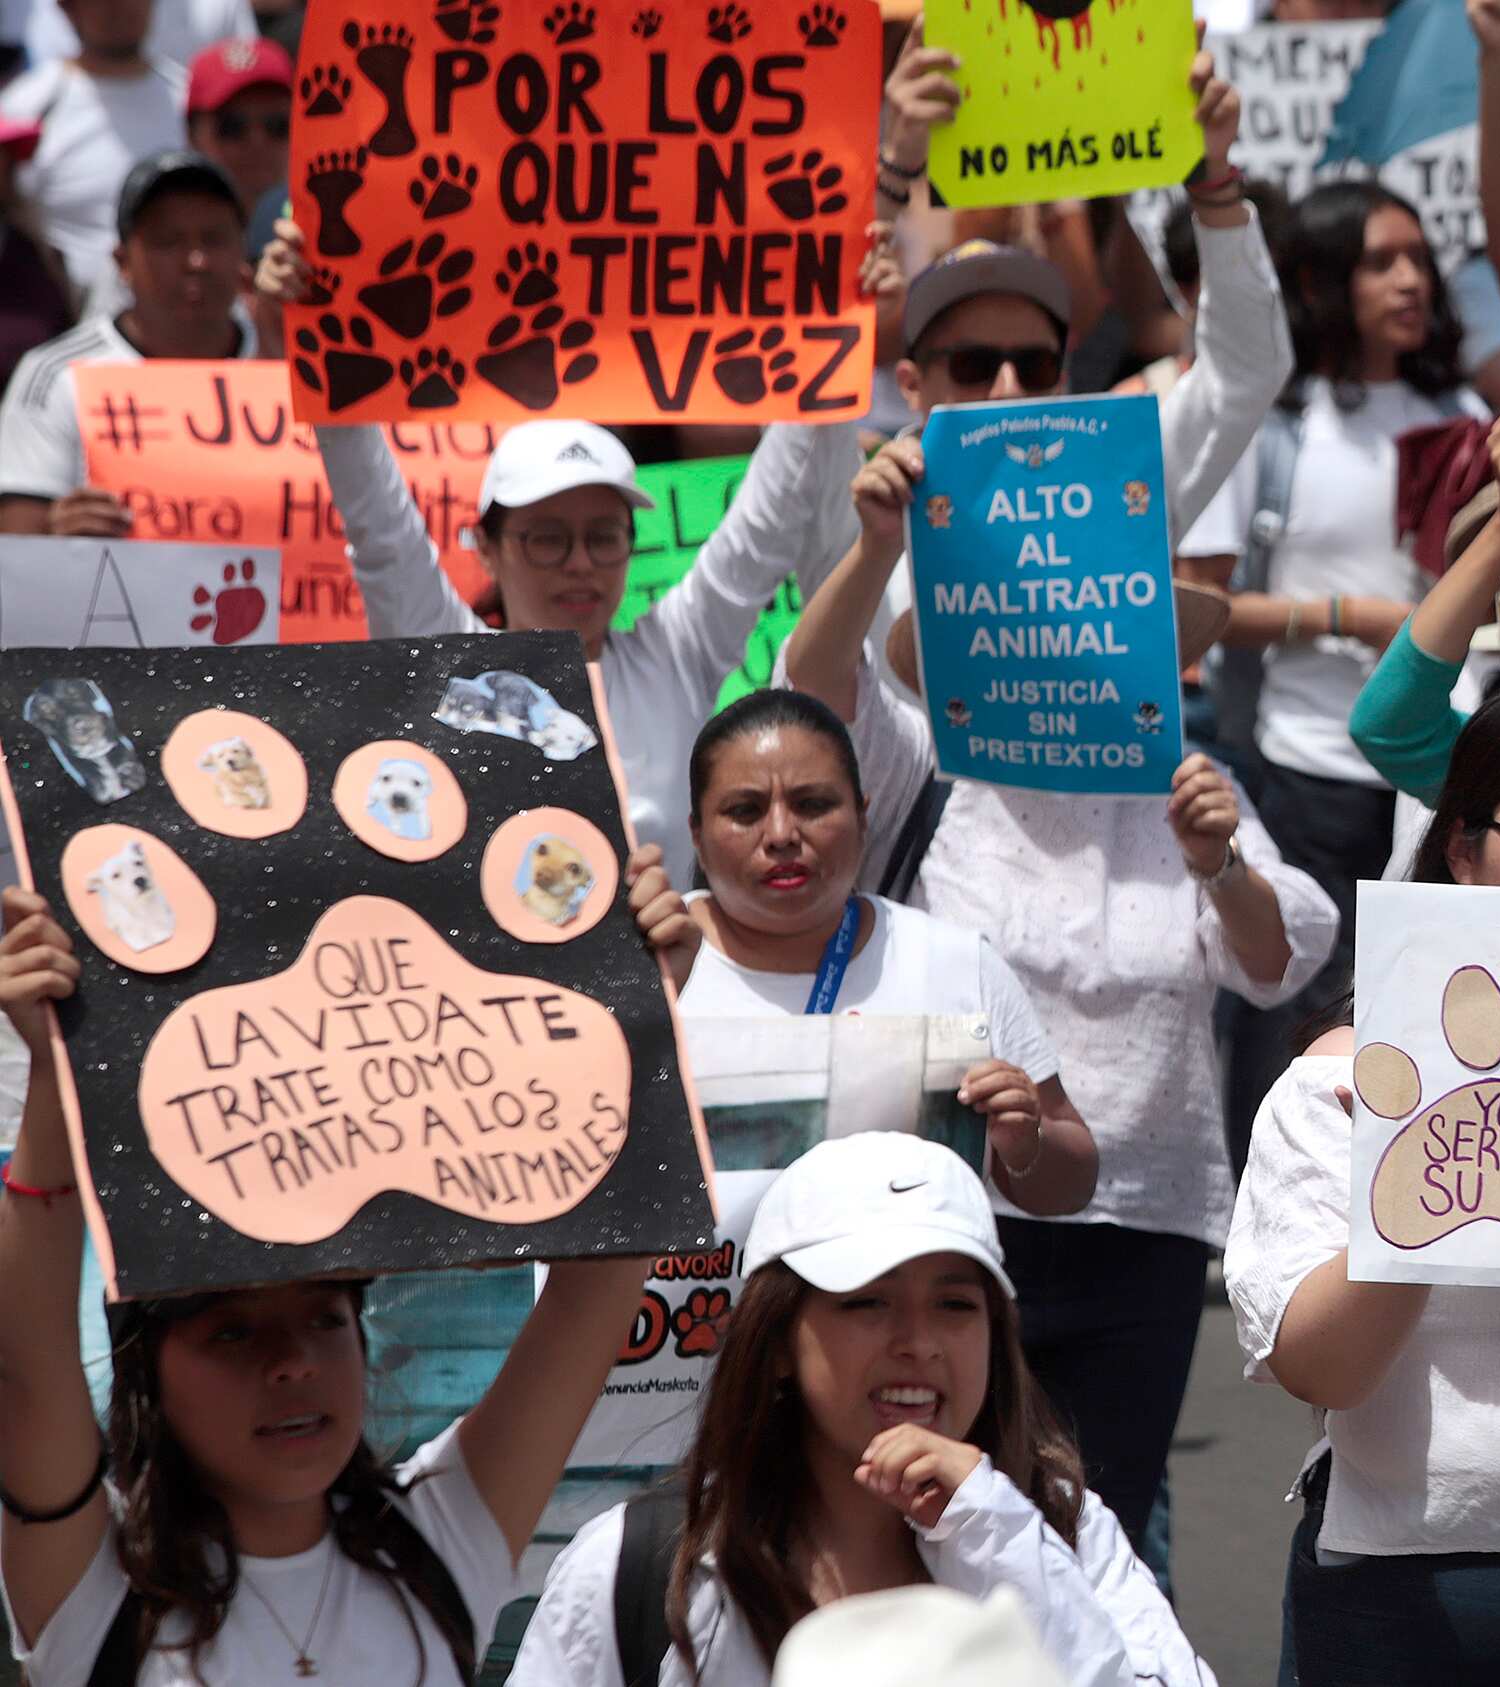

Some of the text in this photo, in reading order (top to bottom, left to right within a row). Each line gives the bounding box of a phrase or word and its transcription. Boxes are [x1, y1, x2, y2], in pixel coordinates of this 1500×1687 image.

[433, 51, 805, 136] POR LOS
[960, 118, 1163, 180] NO MÁS OLÉ
[499, 140, 659, 226] QUE
[570, 234, 843, 317] TIENEN
[630, 325, 862, 412] VZ
[121, 489, 242, 540] Para
[986, 483, 1092, 525] ALTO
[1016, 532, 1071, 568] AL
[933, 572, 1158, 616] MALTRATO
[969, 620, 1129, 659] ANIMAL
[983, 679, 1120, 705] JUSTICIA
[968, 736, 1146, 769] PRETEXTOS
[1028, 712, 1077, 737] SIN
[314, 937, 428, 999] QUE
[166, 1046, 495, 1155] TRATE COMO
[207, 1077, 560, 1199] TRATAS A LOS
[432, 1092, 627, 1212] ANIMALES
[1420, 1164, 1483, 1217] SU
